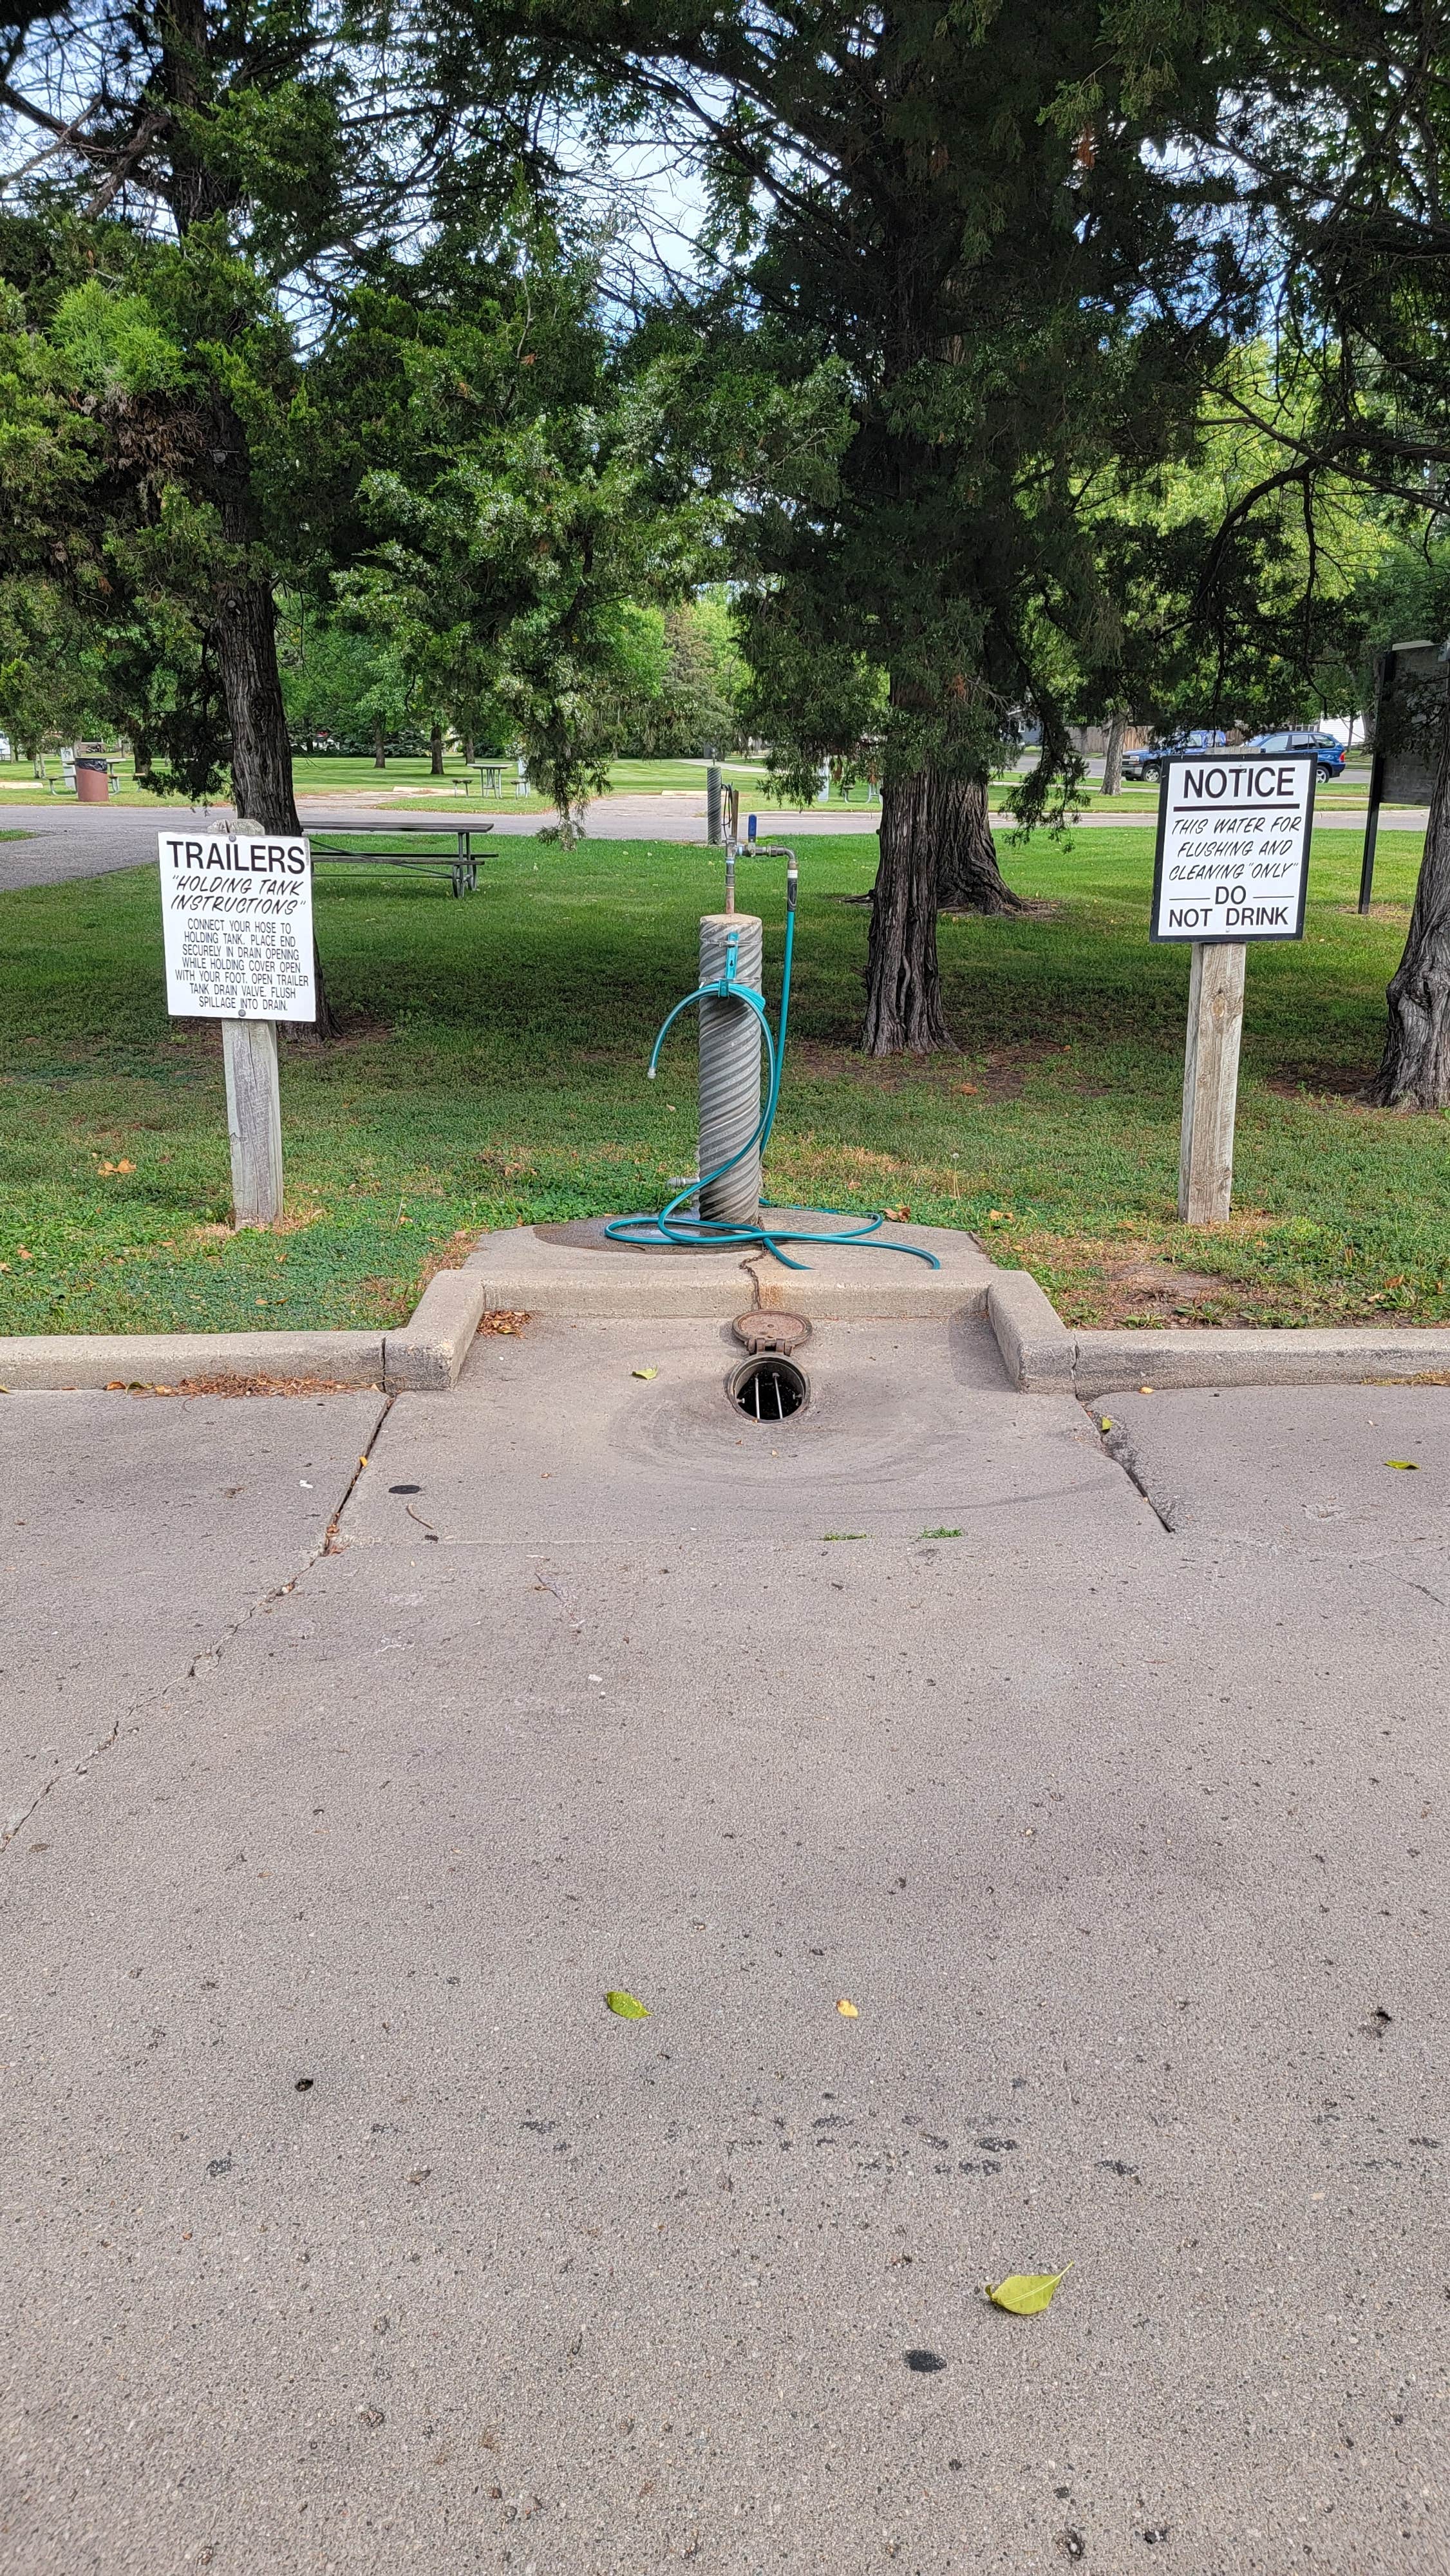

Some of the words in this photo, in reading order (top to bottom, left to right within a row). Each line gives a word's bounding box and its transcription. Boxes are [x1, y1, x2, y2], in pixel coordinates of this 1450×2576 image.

[1183, 767, 1295, 799] NOTICE
[1172, 819, 1208, 835] THIS
[1214, 817, 1265, 834] WATER
[1270, 817, 1302, 832] FOR
[1178, 840, 1254, 858] FLUSHING
[1258, 840, 1292, 855] AND
[167, 841, 305, 875] TRAILERS
[1169, 863, 1245, 880] CLEANING
[259, 879, 304, 896] TANK
[1215, 885, 1247, 905] DO
[1169, 908, 1212, 927] NOT
[1226, 907, 1289, 926] DRINK
[188, 918, 225, 931] CONNECT
[229, 920, 250, 932] YOUR
[255, 922, 276, 933] HOSE
[281, 923, 291, 934] TO
[184, 931, 218, 943] HOLDING
[223, 934, 245, 945] TANK.
[251, 934, 276, 946] PLACE
[280, 936, 296, 947] END
[183, 945, 221, 957] SECURELY
[227, 947, 234, 957] IN
[238, 947, 261, 959] DRAIN
[266, 949, 299, 960] OPENING
[182, 957, 206, 969] WHILE
[211, 959, 244, 971] HOLDING
[249, 961, 275, 972] COVER
[280, 962, 300, 973] OPEN
[175, 969, 194, 981] WITH
[199, 971, 220, 982] YOUR
[225, 972, 247, 984] FOOT.
[252, 974, 272, 985] OPEN
[277, 974, 308, 986] TRAILER
[190, 983, 209, 994] TANK
[214, 984, 237, 996] DRAIN
[241, 985, 267, 997] VALVE.
[271, 987, 296, 998] FLUSH
[199, 996, 236, 1009] SPILLAGE
[240, 998, 258, 1009] INTO
[263, 999, 287, 1010] DRAIN.
